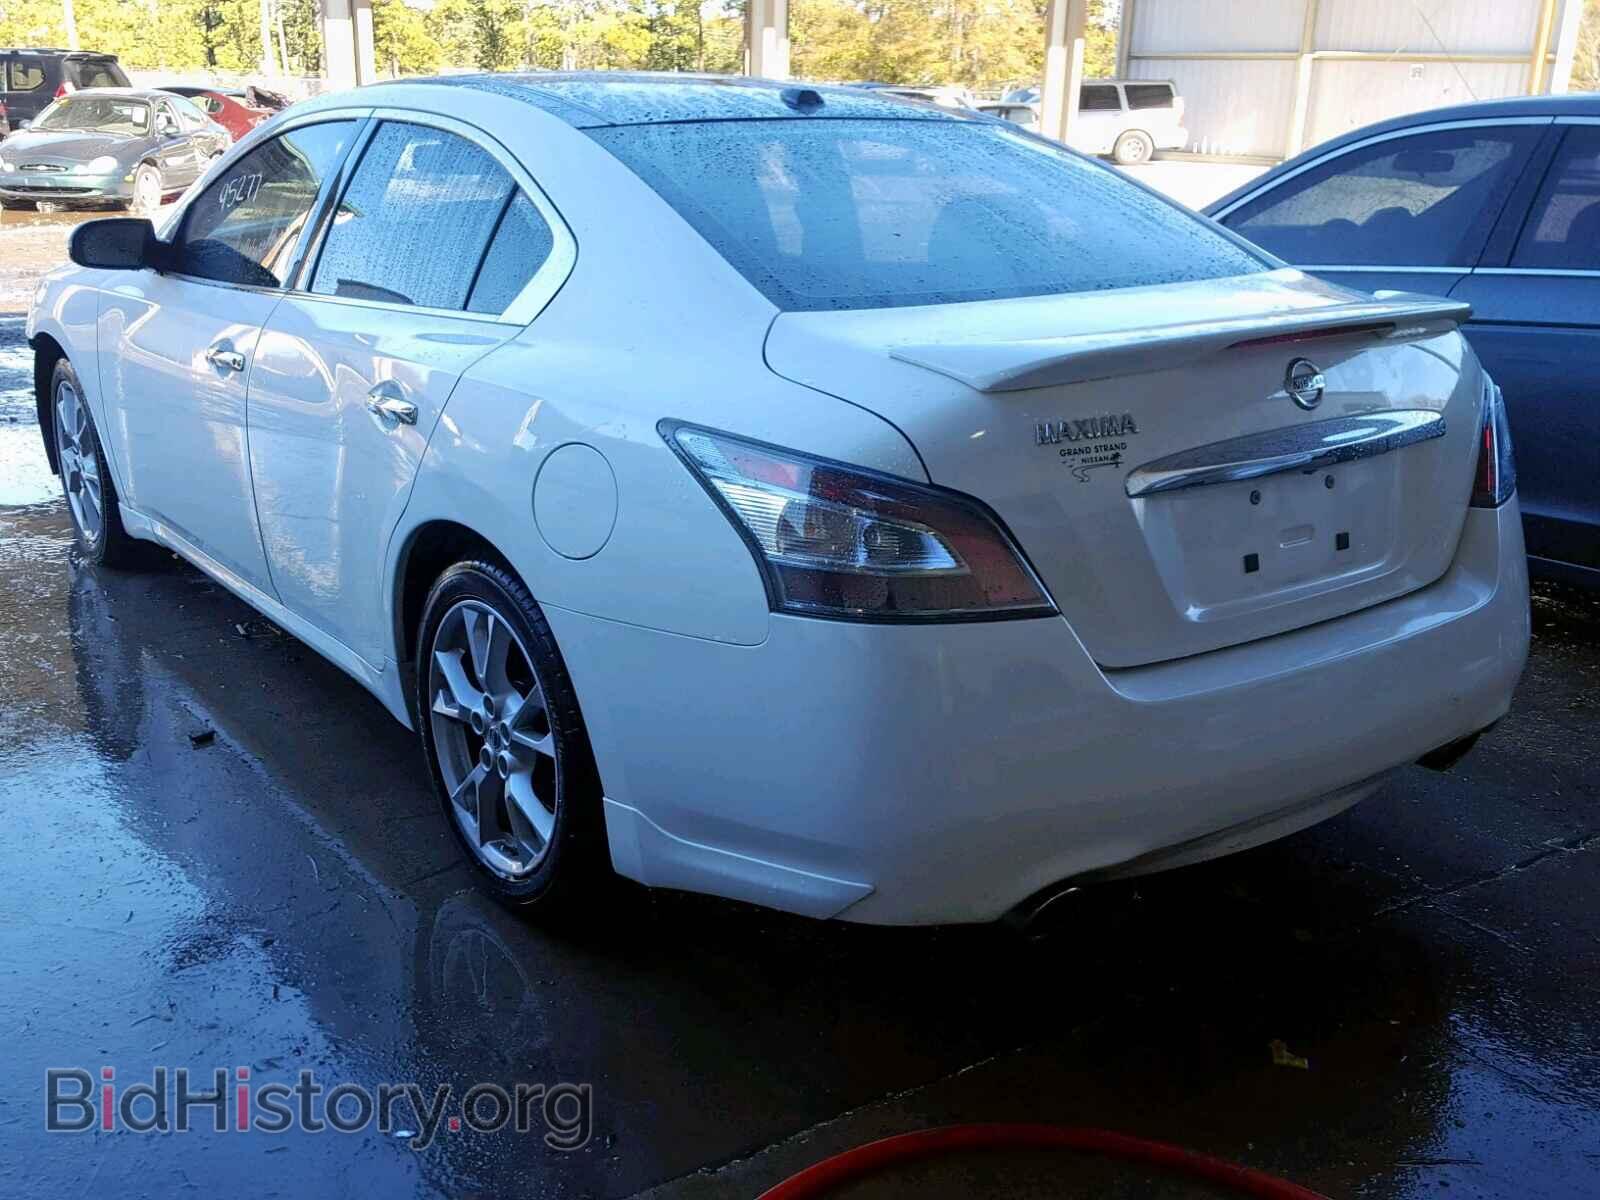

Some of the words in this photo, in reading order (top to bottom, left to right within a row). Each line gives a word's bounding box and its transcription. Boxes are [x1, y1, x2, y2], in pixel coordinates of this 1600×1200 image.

[1035, 414, 1139, 446] MAXIMA
[1059, 445, 1092, 457] GRAND
[1094, 441, 1128, 453] STRAND
